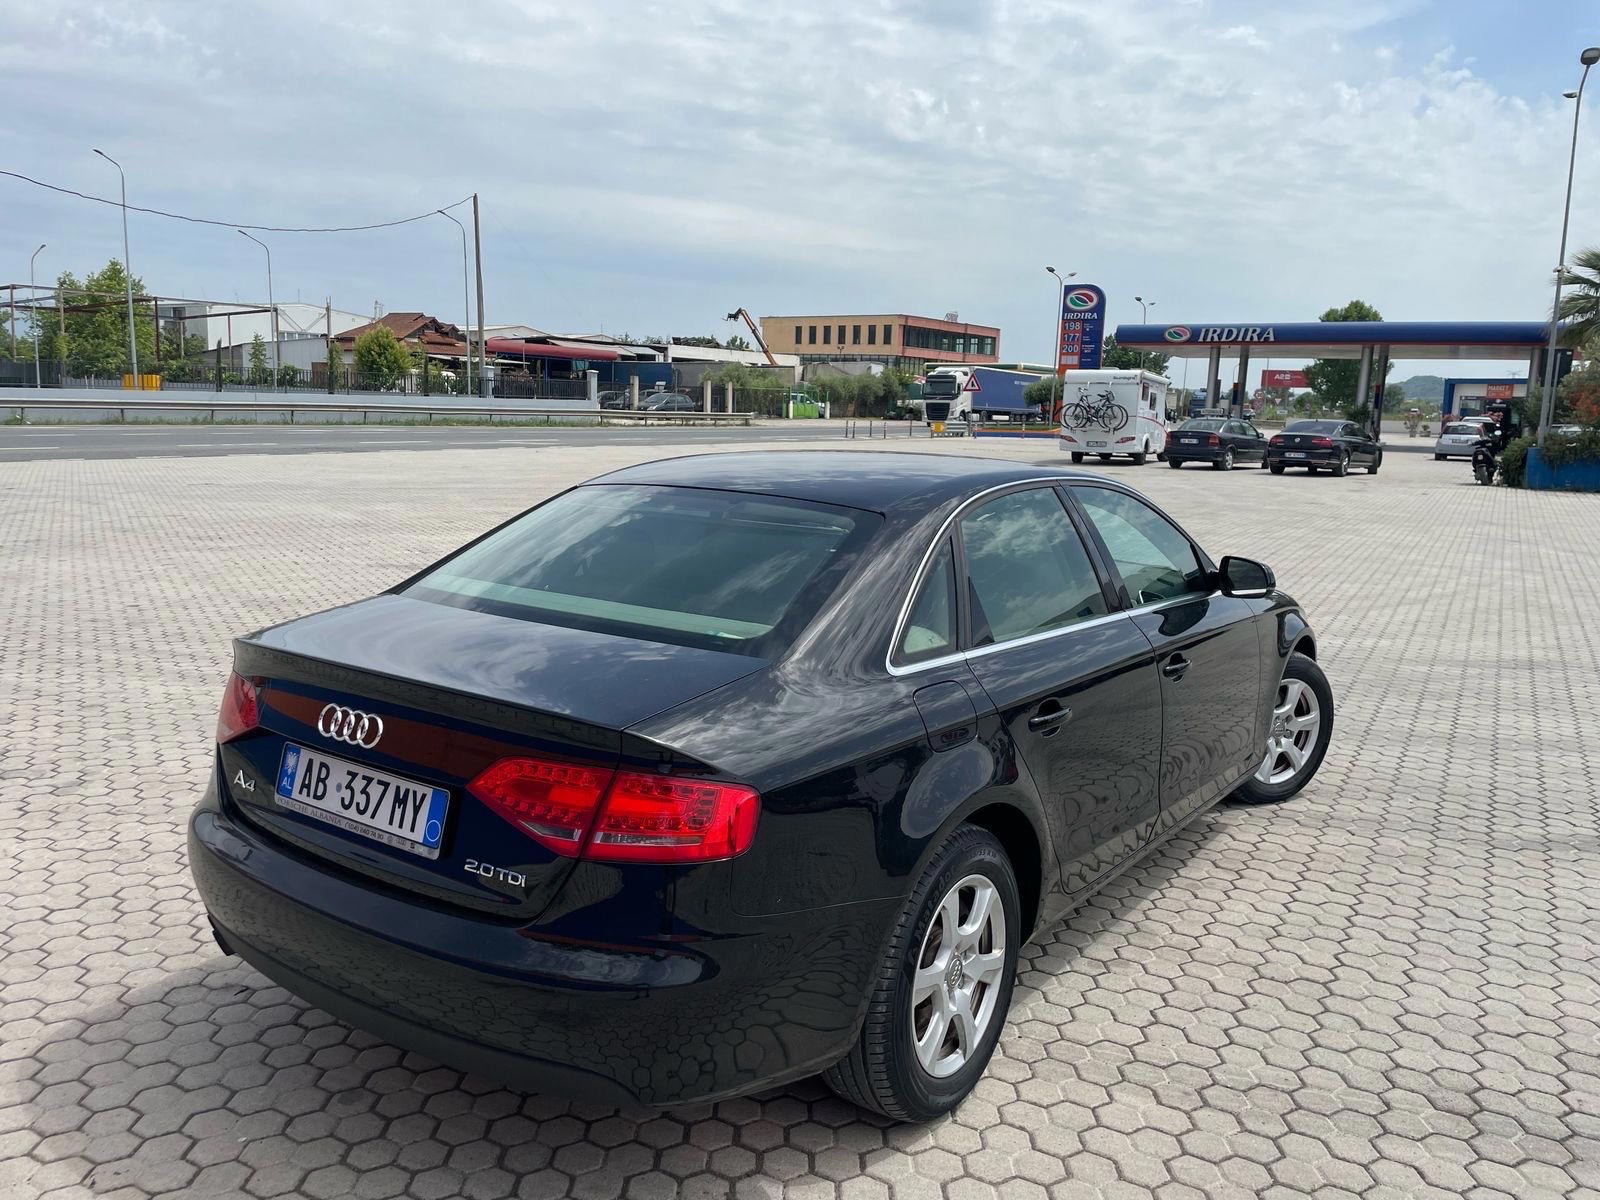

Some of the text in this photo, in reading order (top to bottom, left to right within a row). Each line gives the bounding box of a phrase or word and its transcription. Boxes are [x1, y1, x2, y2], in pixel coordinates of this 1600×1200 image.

[1064, 312, 1098, 320] IRDIRA
[1064, 321, 1081, 330] 198
[1063, 333, 1080, 342] 177
[1197, 327, 1275, 342] IRDIRA
[1062, 344, 1079, 353] 200
[233, 769, 255, 792] A4
[281, 776, 292, 790] AL
[298, 758, 428, 834] AB 337 MY
[311, 809, 342, 827] ALBANIA
[464, 858, 494, 878] 2.0
